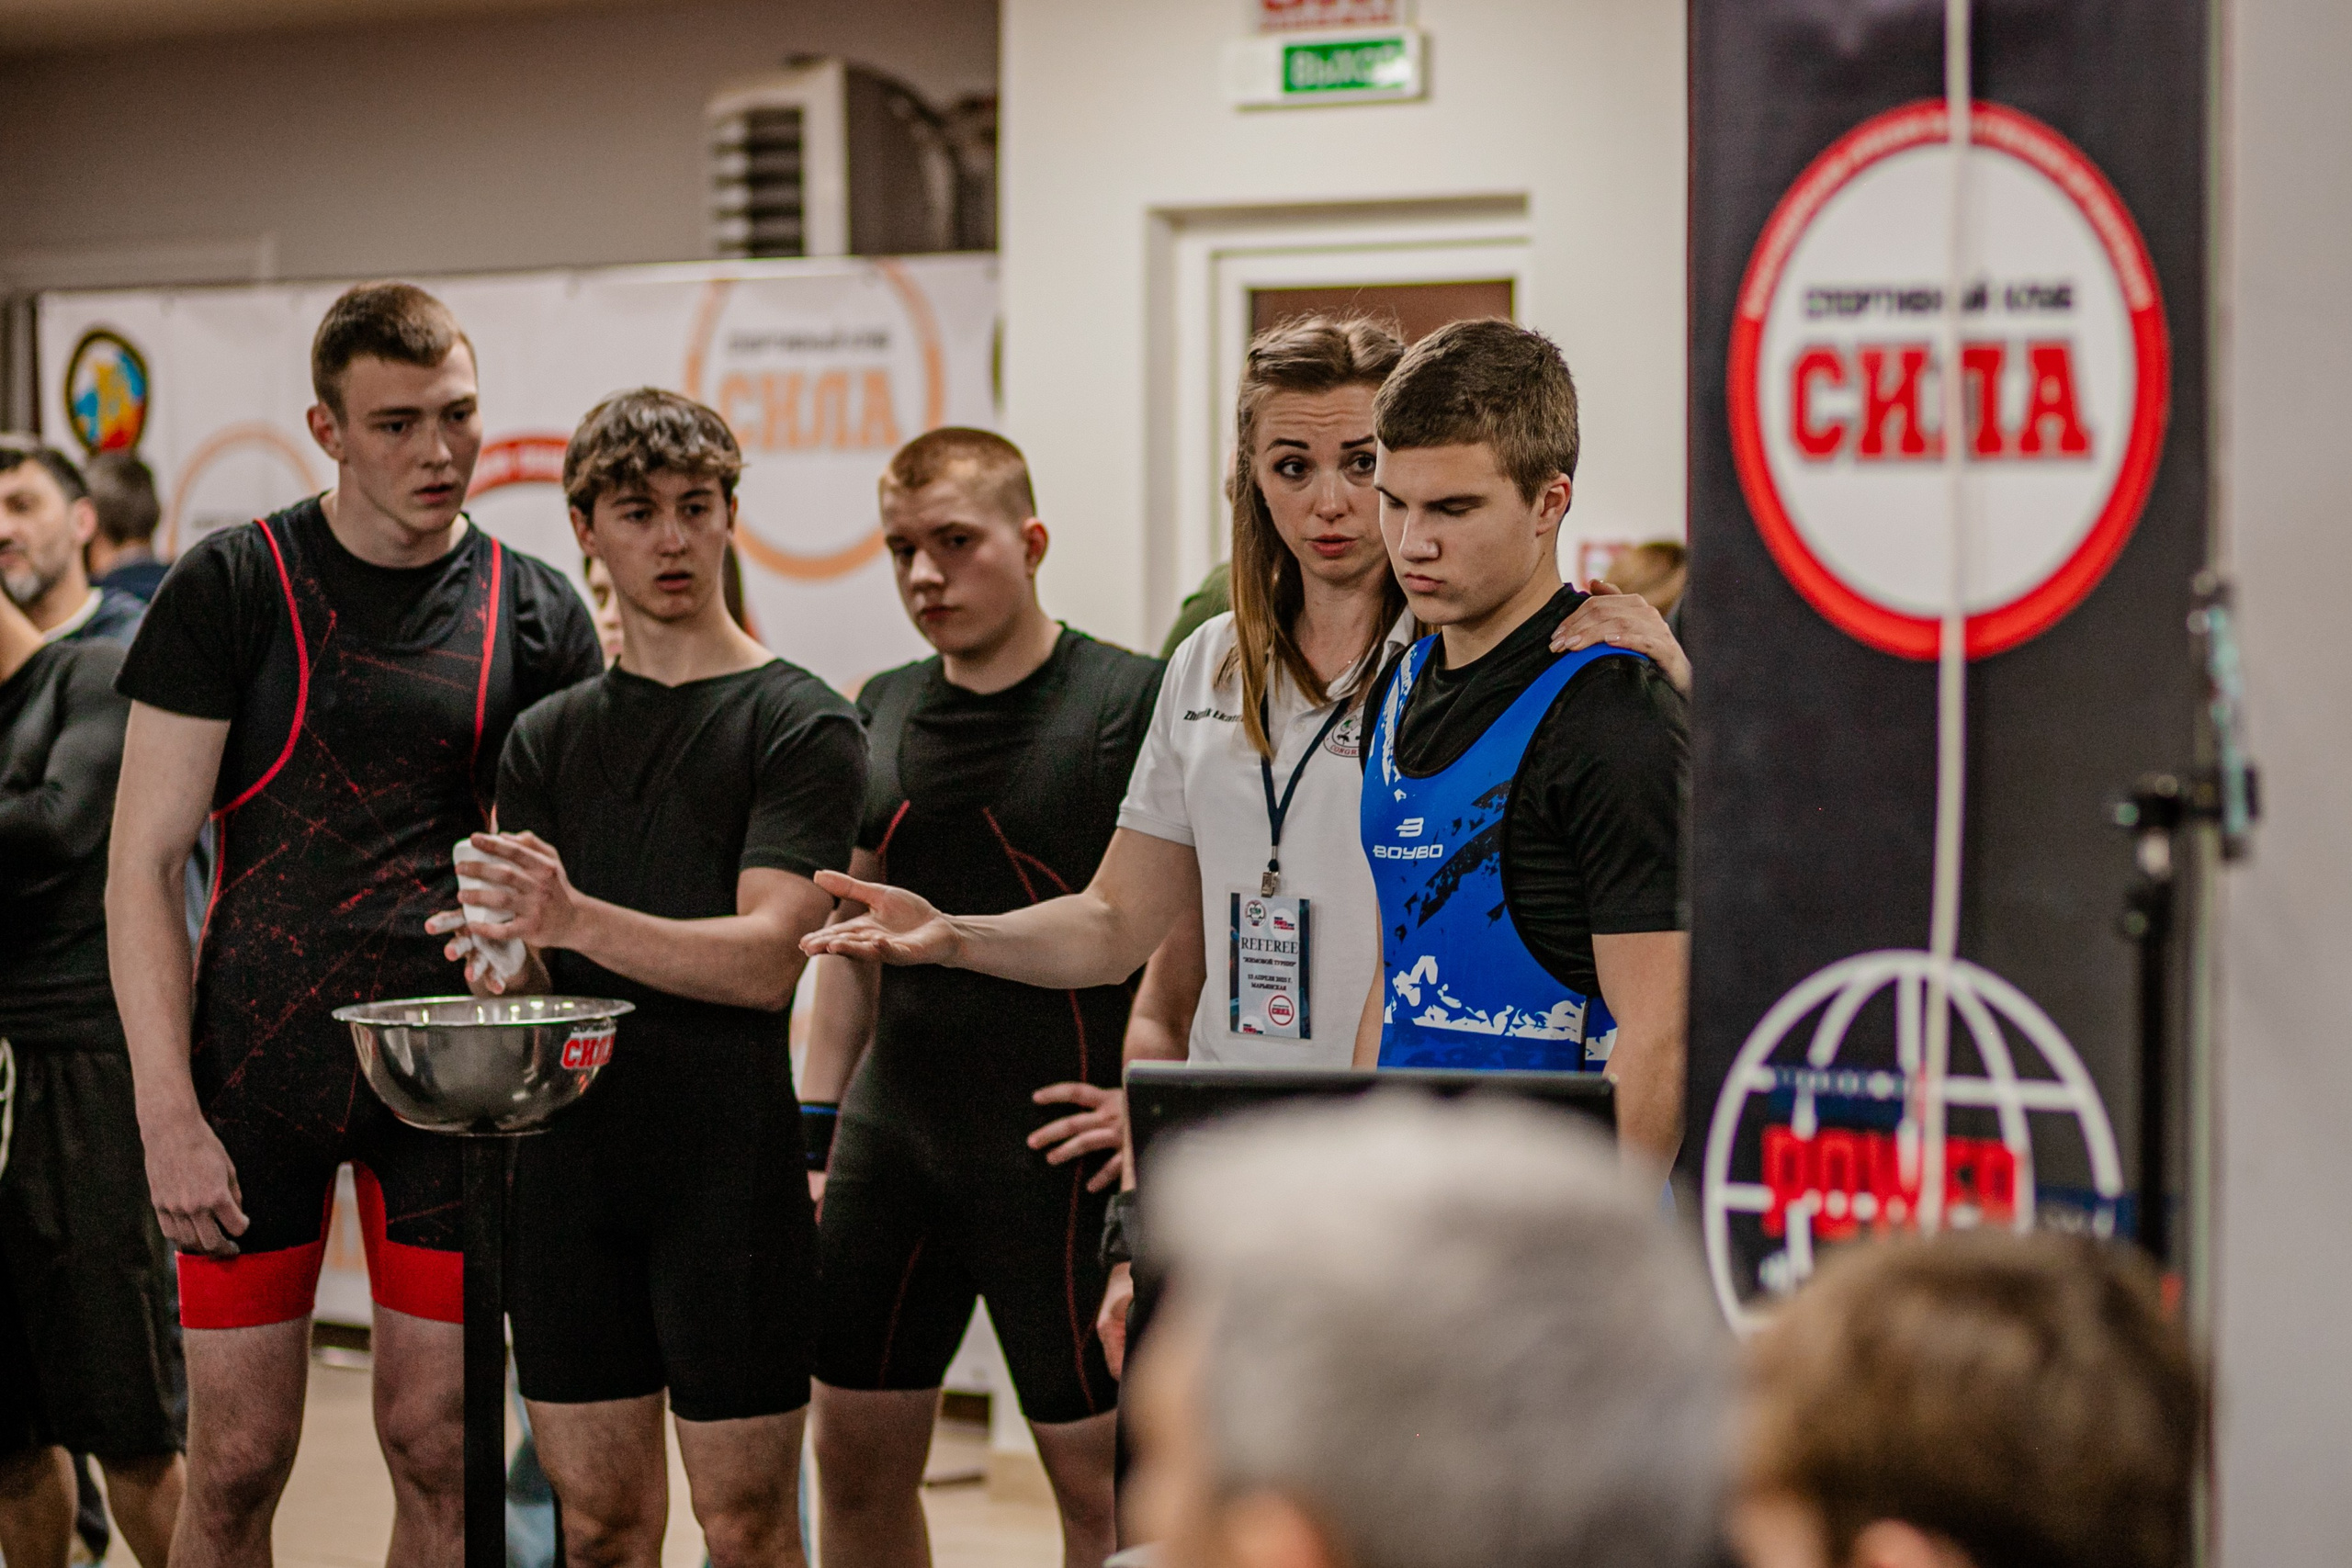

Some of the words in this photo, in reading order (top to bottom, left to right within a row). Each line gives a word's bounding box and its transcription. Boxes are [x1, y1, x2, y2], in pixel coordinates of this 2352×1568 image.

[1805, 282, 1987, 316] СПОРТИВНЙ
[719, 370, 900, 449] СИЛА
[1330, 745, 1358, 756] CONGR
[1373, 844, 1443, 860] BOYBO
[1240, 937, 1298, 955] REFEREE
[561, 1035, 616, 1068] СИЛ
